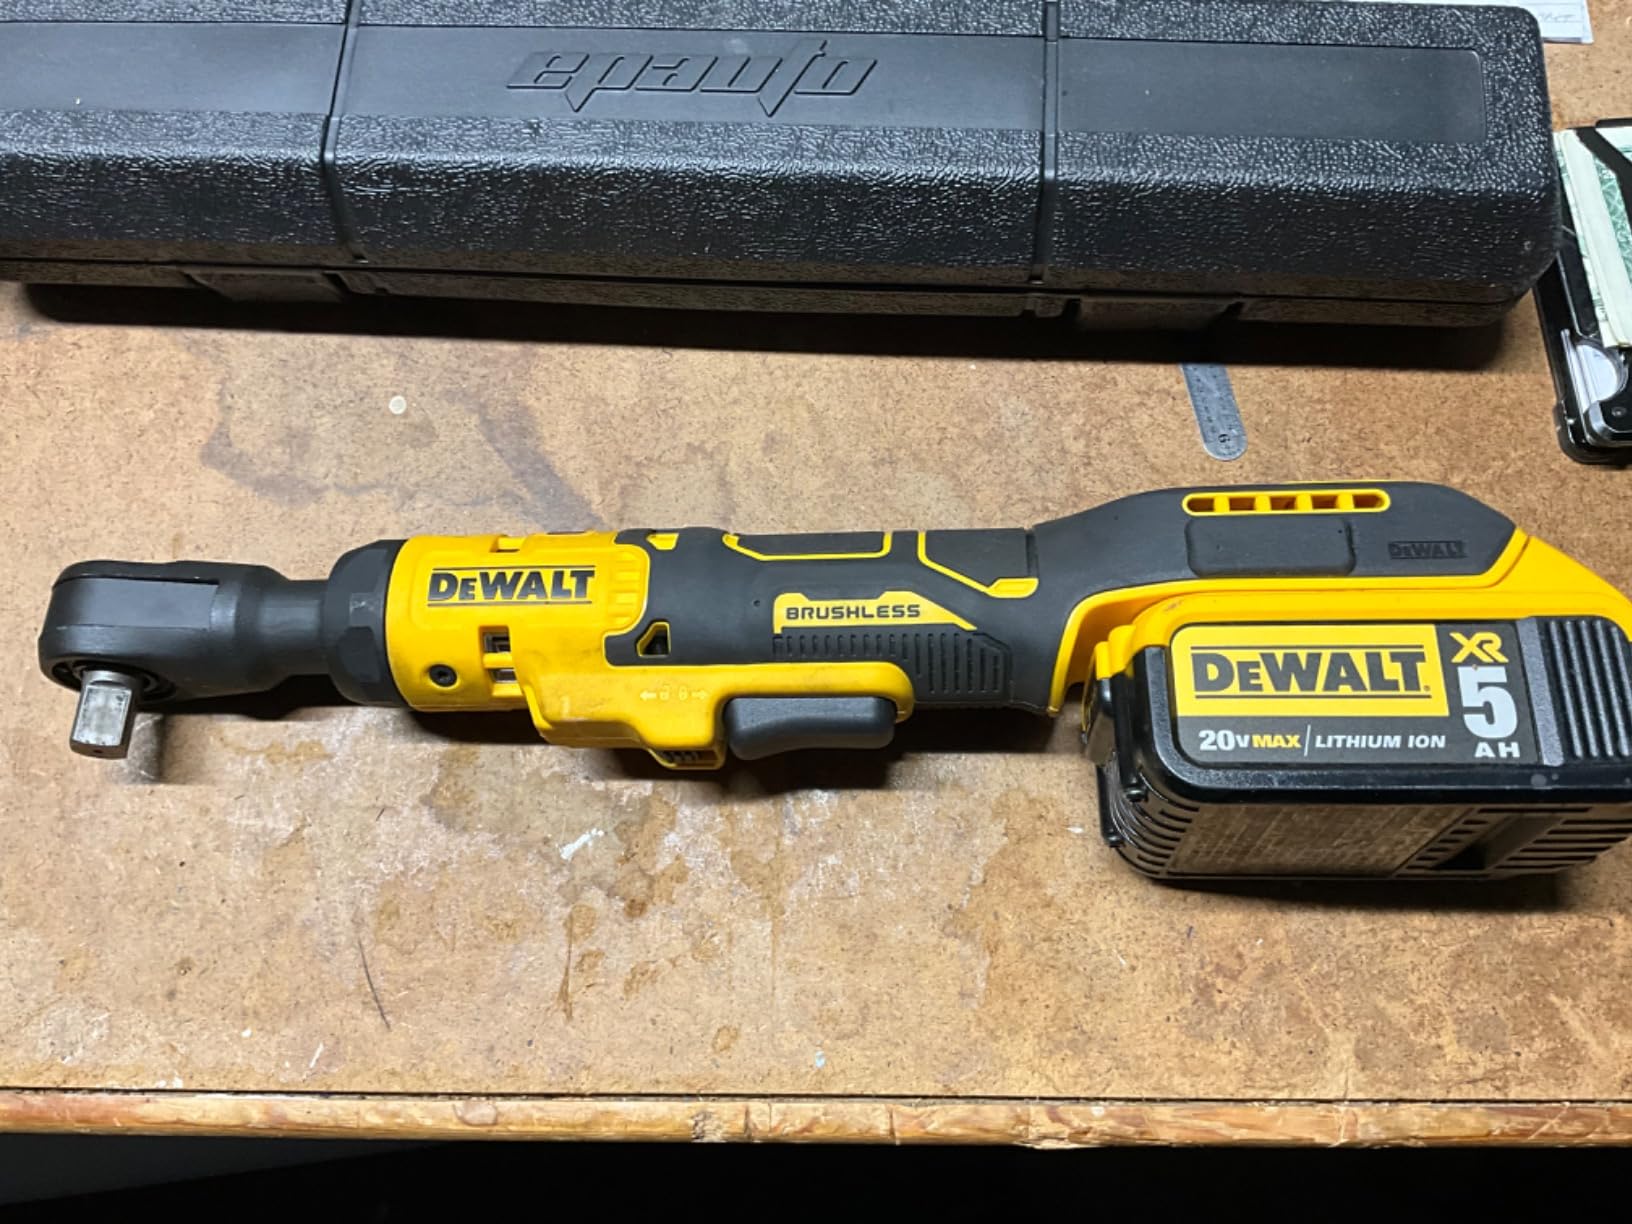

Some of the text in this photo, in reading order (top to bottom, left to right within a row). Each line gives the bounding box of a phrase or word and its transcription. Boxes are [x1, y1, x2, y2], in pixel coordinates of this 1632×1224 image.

[427, 570, 595, 601] DEWALT
[785, 604, 922, 621] BRUSHLESS
[1449, 631, 1509, 663] XR
[1191, 651, 1432, 693] DEWALT
[1457, 666, 1518, 739] 5
[1315, 734, 1401, 749] LITHIUM
[1407, 735, 1446, 749] ION
[1474, 742, 1521, 759] AH
